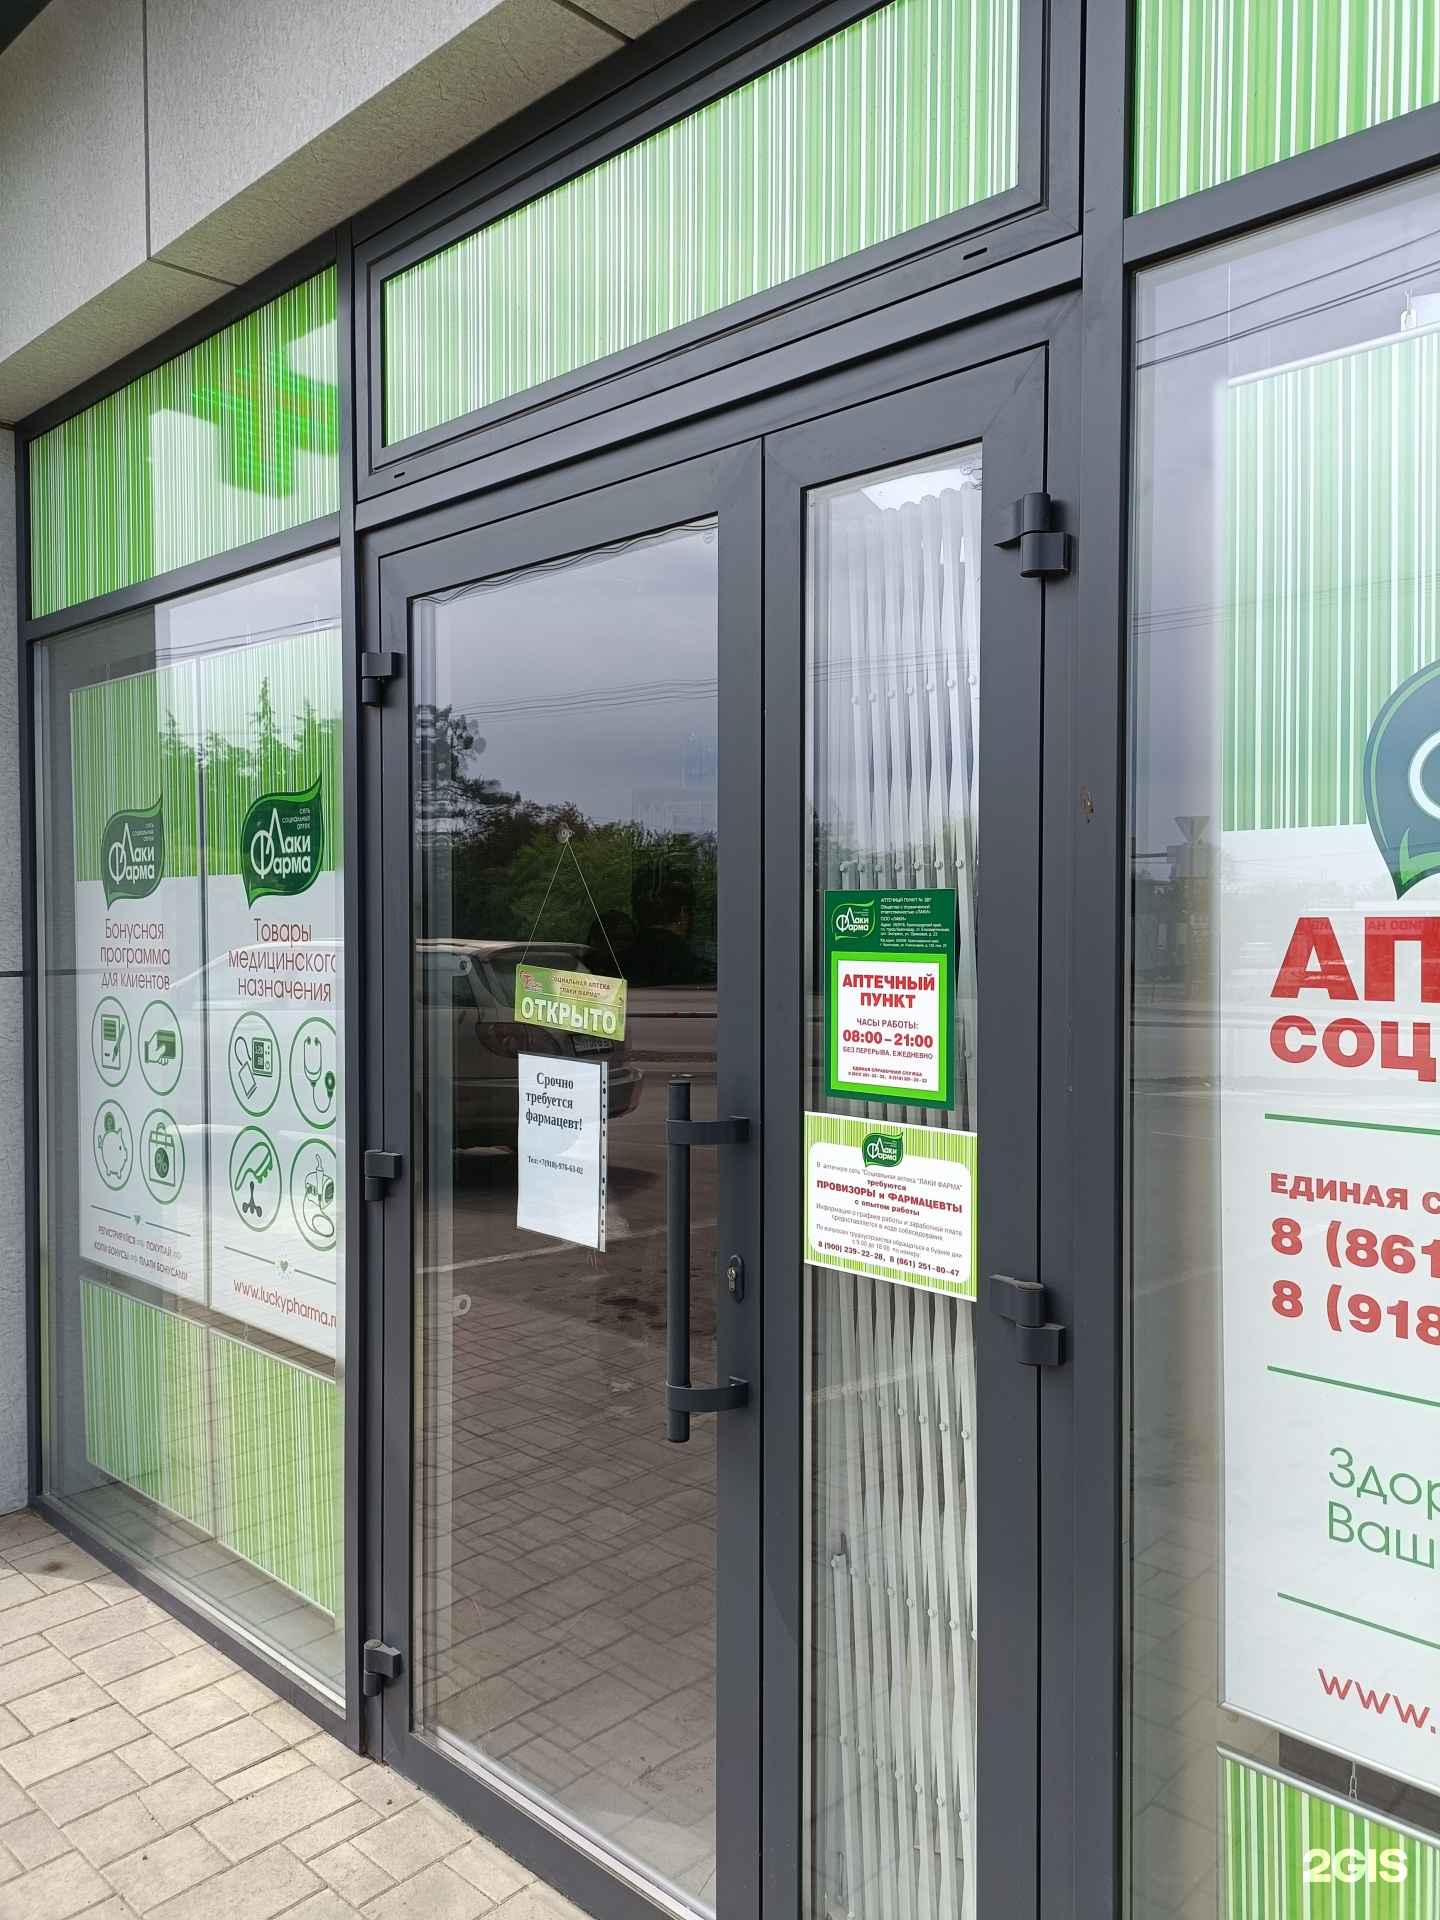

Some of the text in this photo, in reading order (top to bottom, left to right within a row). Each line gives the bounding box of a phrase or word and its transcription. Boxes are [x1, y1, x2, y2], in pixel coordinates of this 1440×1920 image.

[105, 918, 164, 945] Бонусная
[253, 917, 312, 949] Товары
[100, 946, 171, 969] программа
[101, 971, 170, 991] для клиентов
[238, 977, 332, 1003] назначения
[842, 973, 935, 991] АПТЕЧНЫЙ
[860, 991, 916, 1009] ПУНКТ
[521, 996, 617, 1035] ОТКРЫТО
[856, 1017, 919, 1030] ЧАСЫ РАБОТЫ:
[1269, 1014, 1437, 1083] СОЦ
[536, 1072, 574, 1090] Срочно
[525, 1092, 573, 1110] требуется
[525, 1107, 583, 1131] фармацевт!
[816, 1179, 963, 1214] ПРОВИЗОРЫ и ФАРМАЦЕВТЫ
[867, 1179, 907, 1192] требуются
[1270, 1172, 1409, 1211] ЕДИНАЯ
[861, 1200, 890, 1211] опытом
[891, 1205, 920, 1217] работы
[1271, 1217, 1303, 1256] 8
[1271, 1279, 1440, 1346] 8 (918
[1328, 1500, 1435, 1569] Ваш
